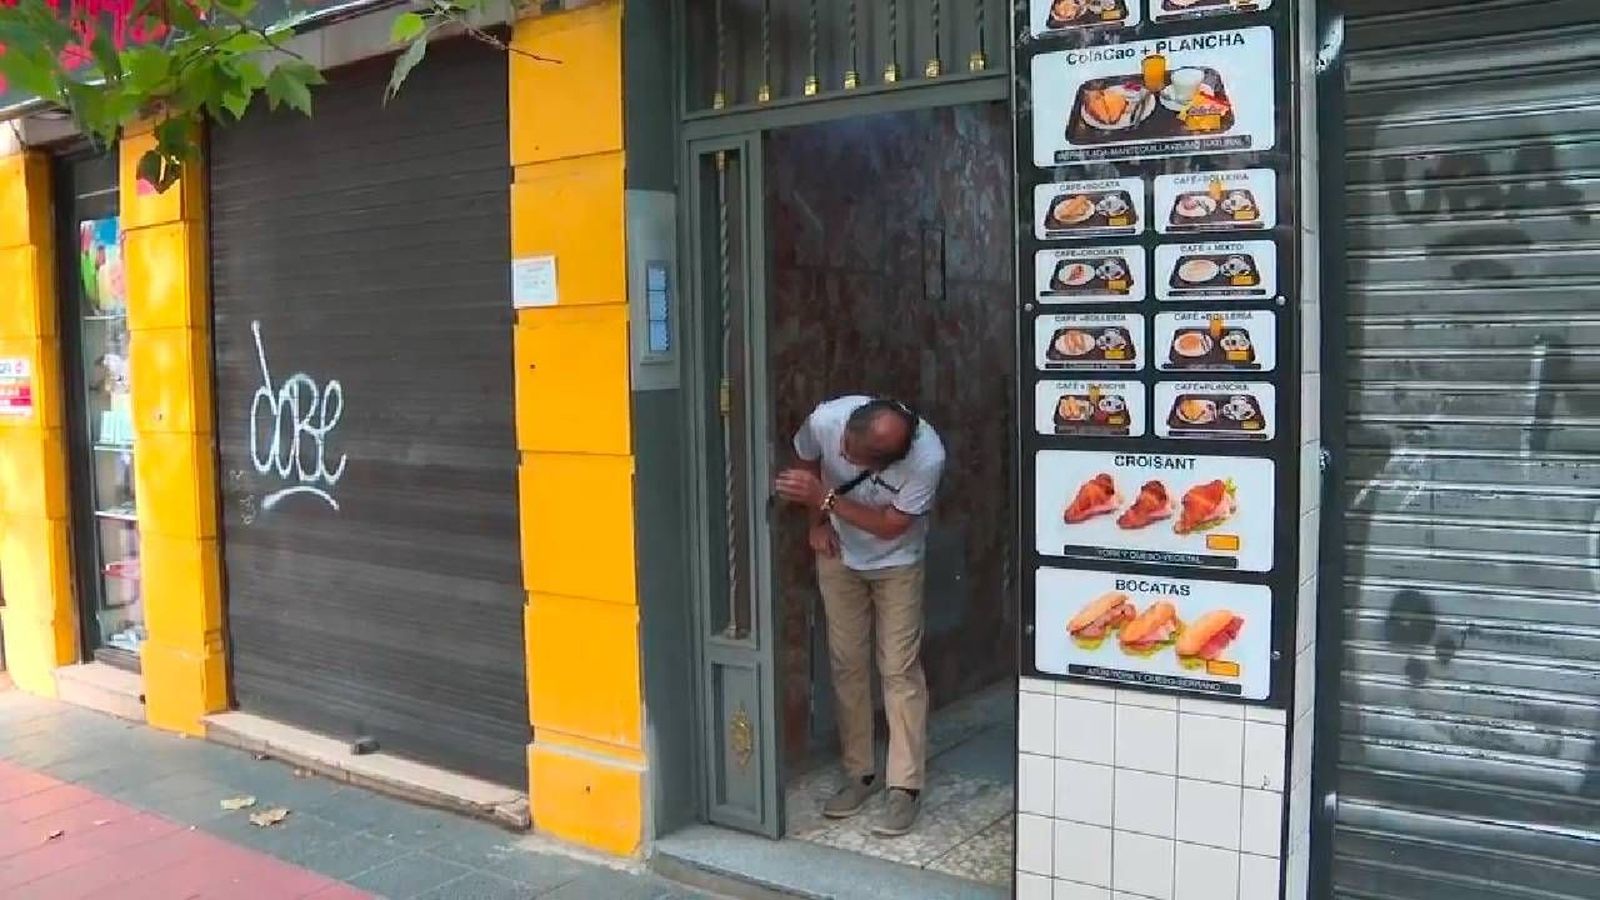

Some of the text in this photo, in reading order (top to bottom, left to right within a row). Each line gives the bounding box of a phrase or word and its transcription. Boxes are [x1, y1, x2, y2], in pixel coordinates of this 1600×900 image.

[1066, 47, 1136, 66] ColaCao
[1155, 33, 1246, 54] PLANCHA
[1114, 455, 1197, 470] CROISANT
[1115, 579, 1191, 596] BOCATAS
